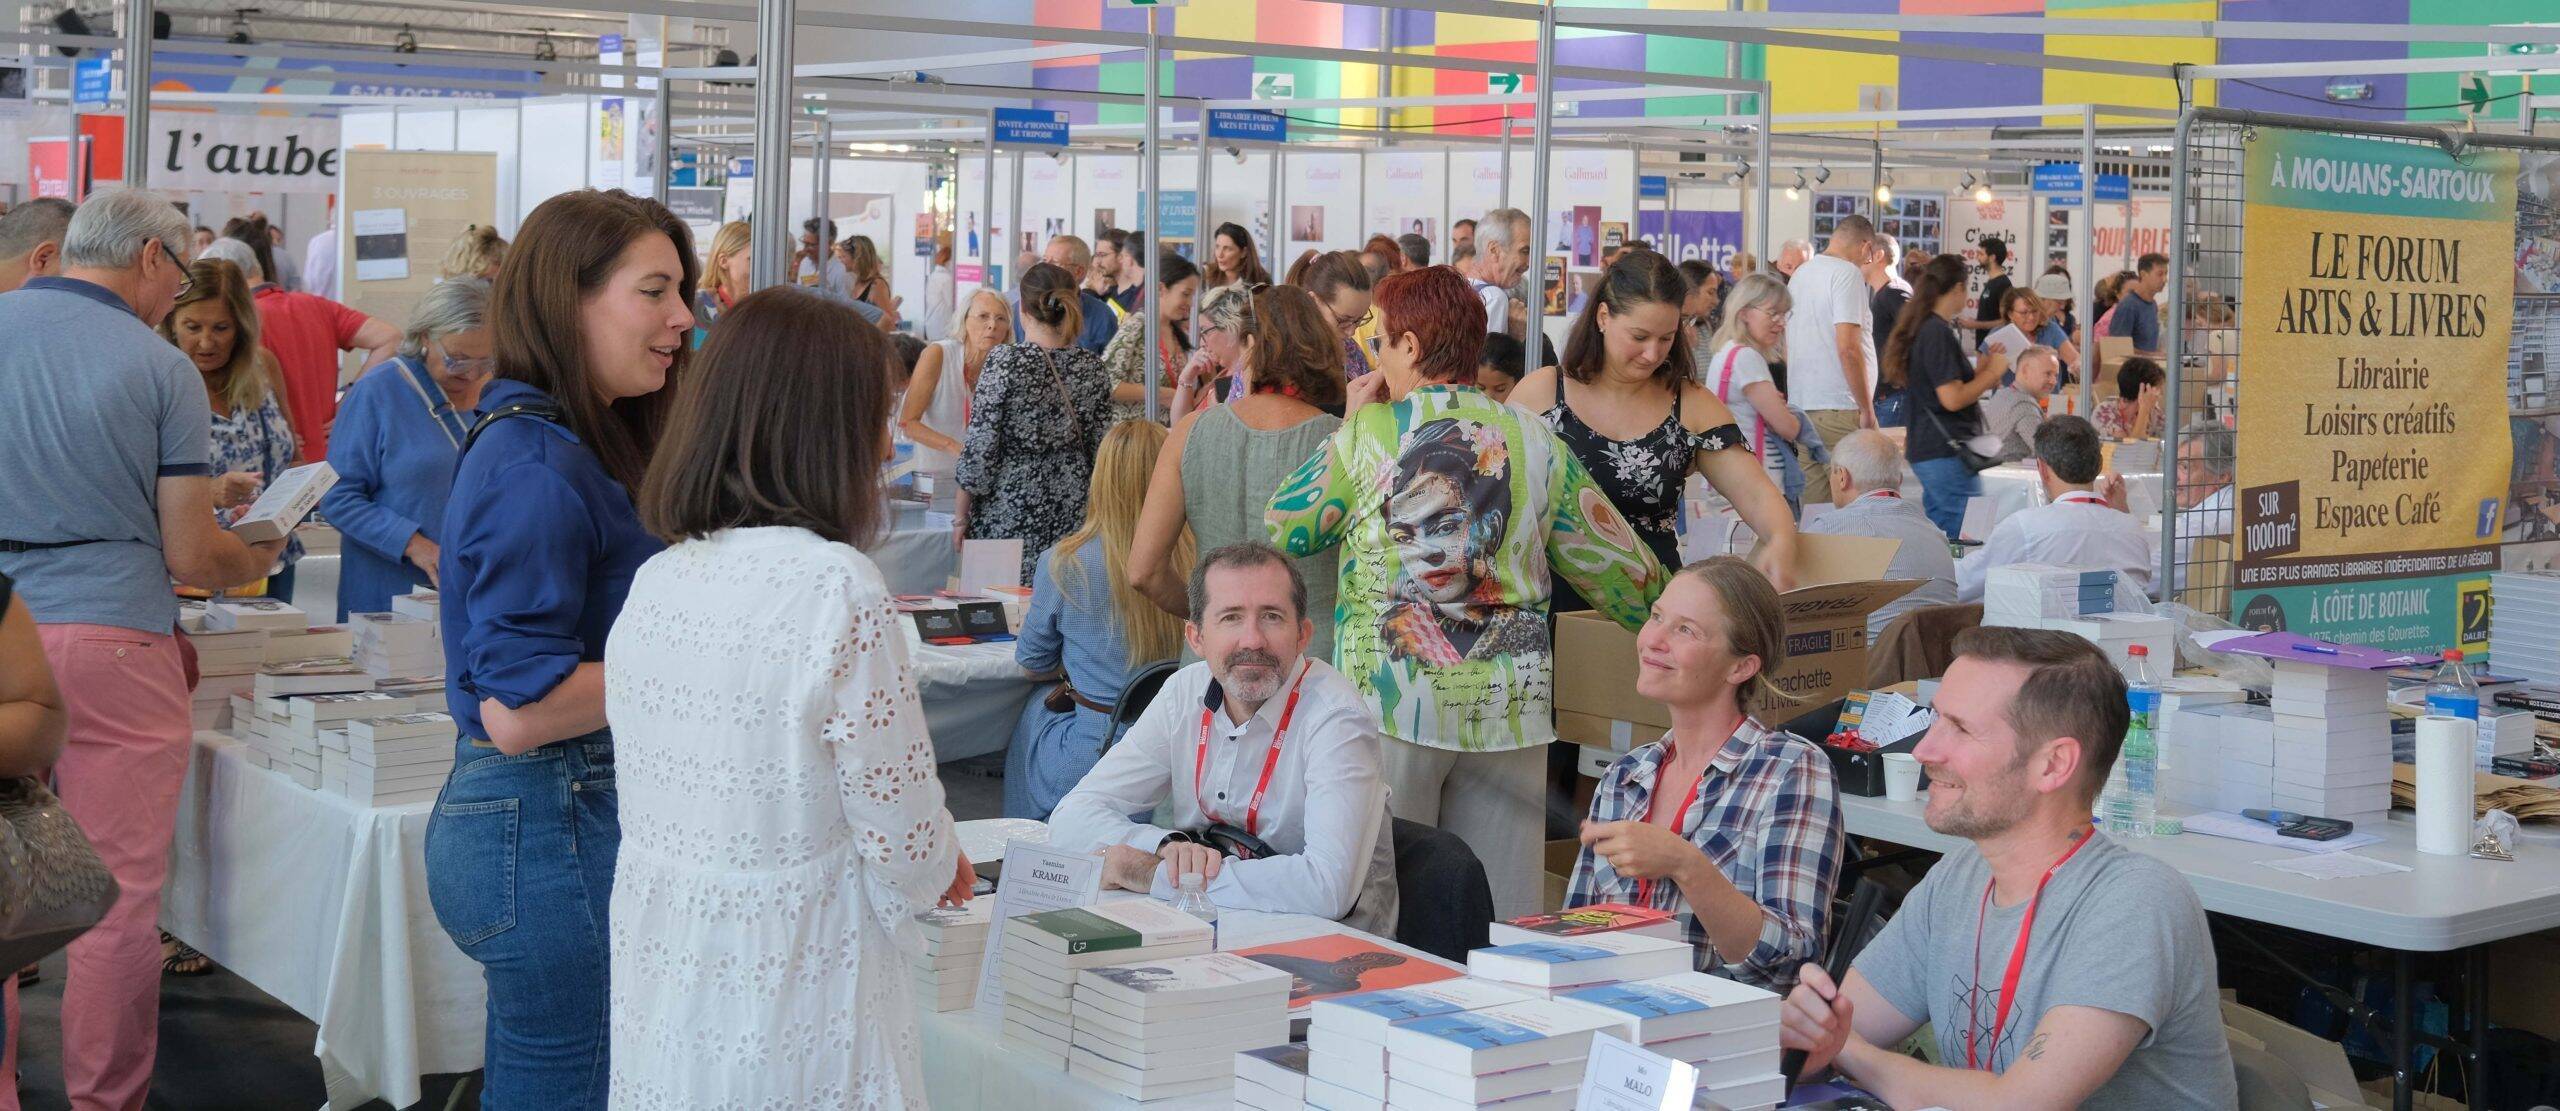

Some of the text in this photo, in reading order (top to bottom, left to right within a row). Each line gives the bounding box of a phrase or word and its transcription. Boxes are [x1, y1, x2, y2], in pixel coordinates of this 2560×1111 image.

[2271, 152, 2496, 203] À MOUANS-SARTOUX
[2309, 231, 2462, 284] LE FORUM
[2275, 287, 2488, 339] ARTS & LIVRES
[2336, 356, 2430, 390] Librairie
[2303, 402, 2456, 436] Loisirs créatifs
[2331, 448, 2429, 491] Papeterie
[2258, 490, 2280, 518] SUR
[2314, 491, 2441, 538] Espace Café
[2260, 566, 2277, 582] DES
[2278, 565, 2300, 581] PLUS
[2447, 555, 2458, 569] DE
[2310, 587, 2431, 624] À CÔTÉ DE BOTANIC
[1787, 634, 1830, 654] FRAGILE
[2333, 628, 2368, 645] chemin
[2369, 626, 2386, 642] des
[2388, 623, 2431, 642] Gourettes
[2463, 630, 2487, 641] DALBE
[1031, 868, 1070, 885] KRAMER
[1623, 1076, 1653, 1098] MALO
